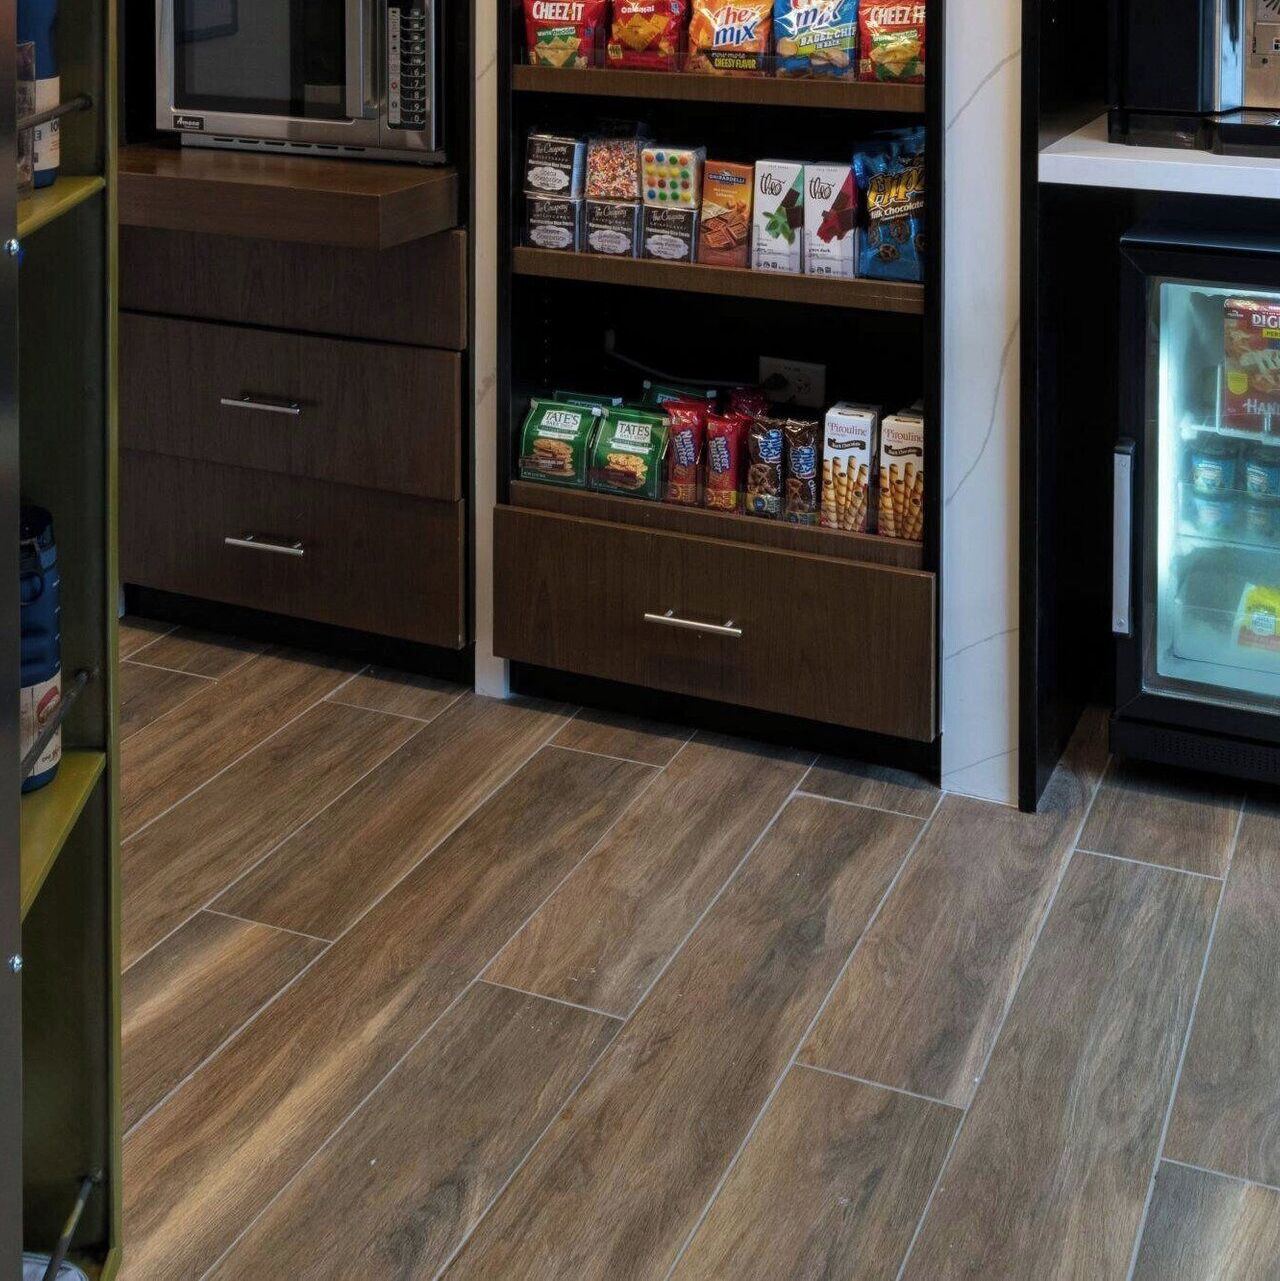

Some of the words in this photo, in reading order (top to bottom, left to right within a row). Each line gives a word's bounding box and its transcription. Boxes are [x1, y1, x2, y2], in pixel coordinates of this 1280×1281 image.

[799, 31, 832, 46] BAGEL
[715, 58, 736, 68] CHEESY
[736, 59, 757, 69] FLAVOR
[760, 172, 786, 197] theo
[809, 177, 836, 200] theo
[545, 411, 580, 426] TATE'S
[618, 422, 650, 437] TATE'S
[682, 429, 695, 462] Nutter
